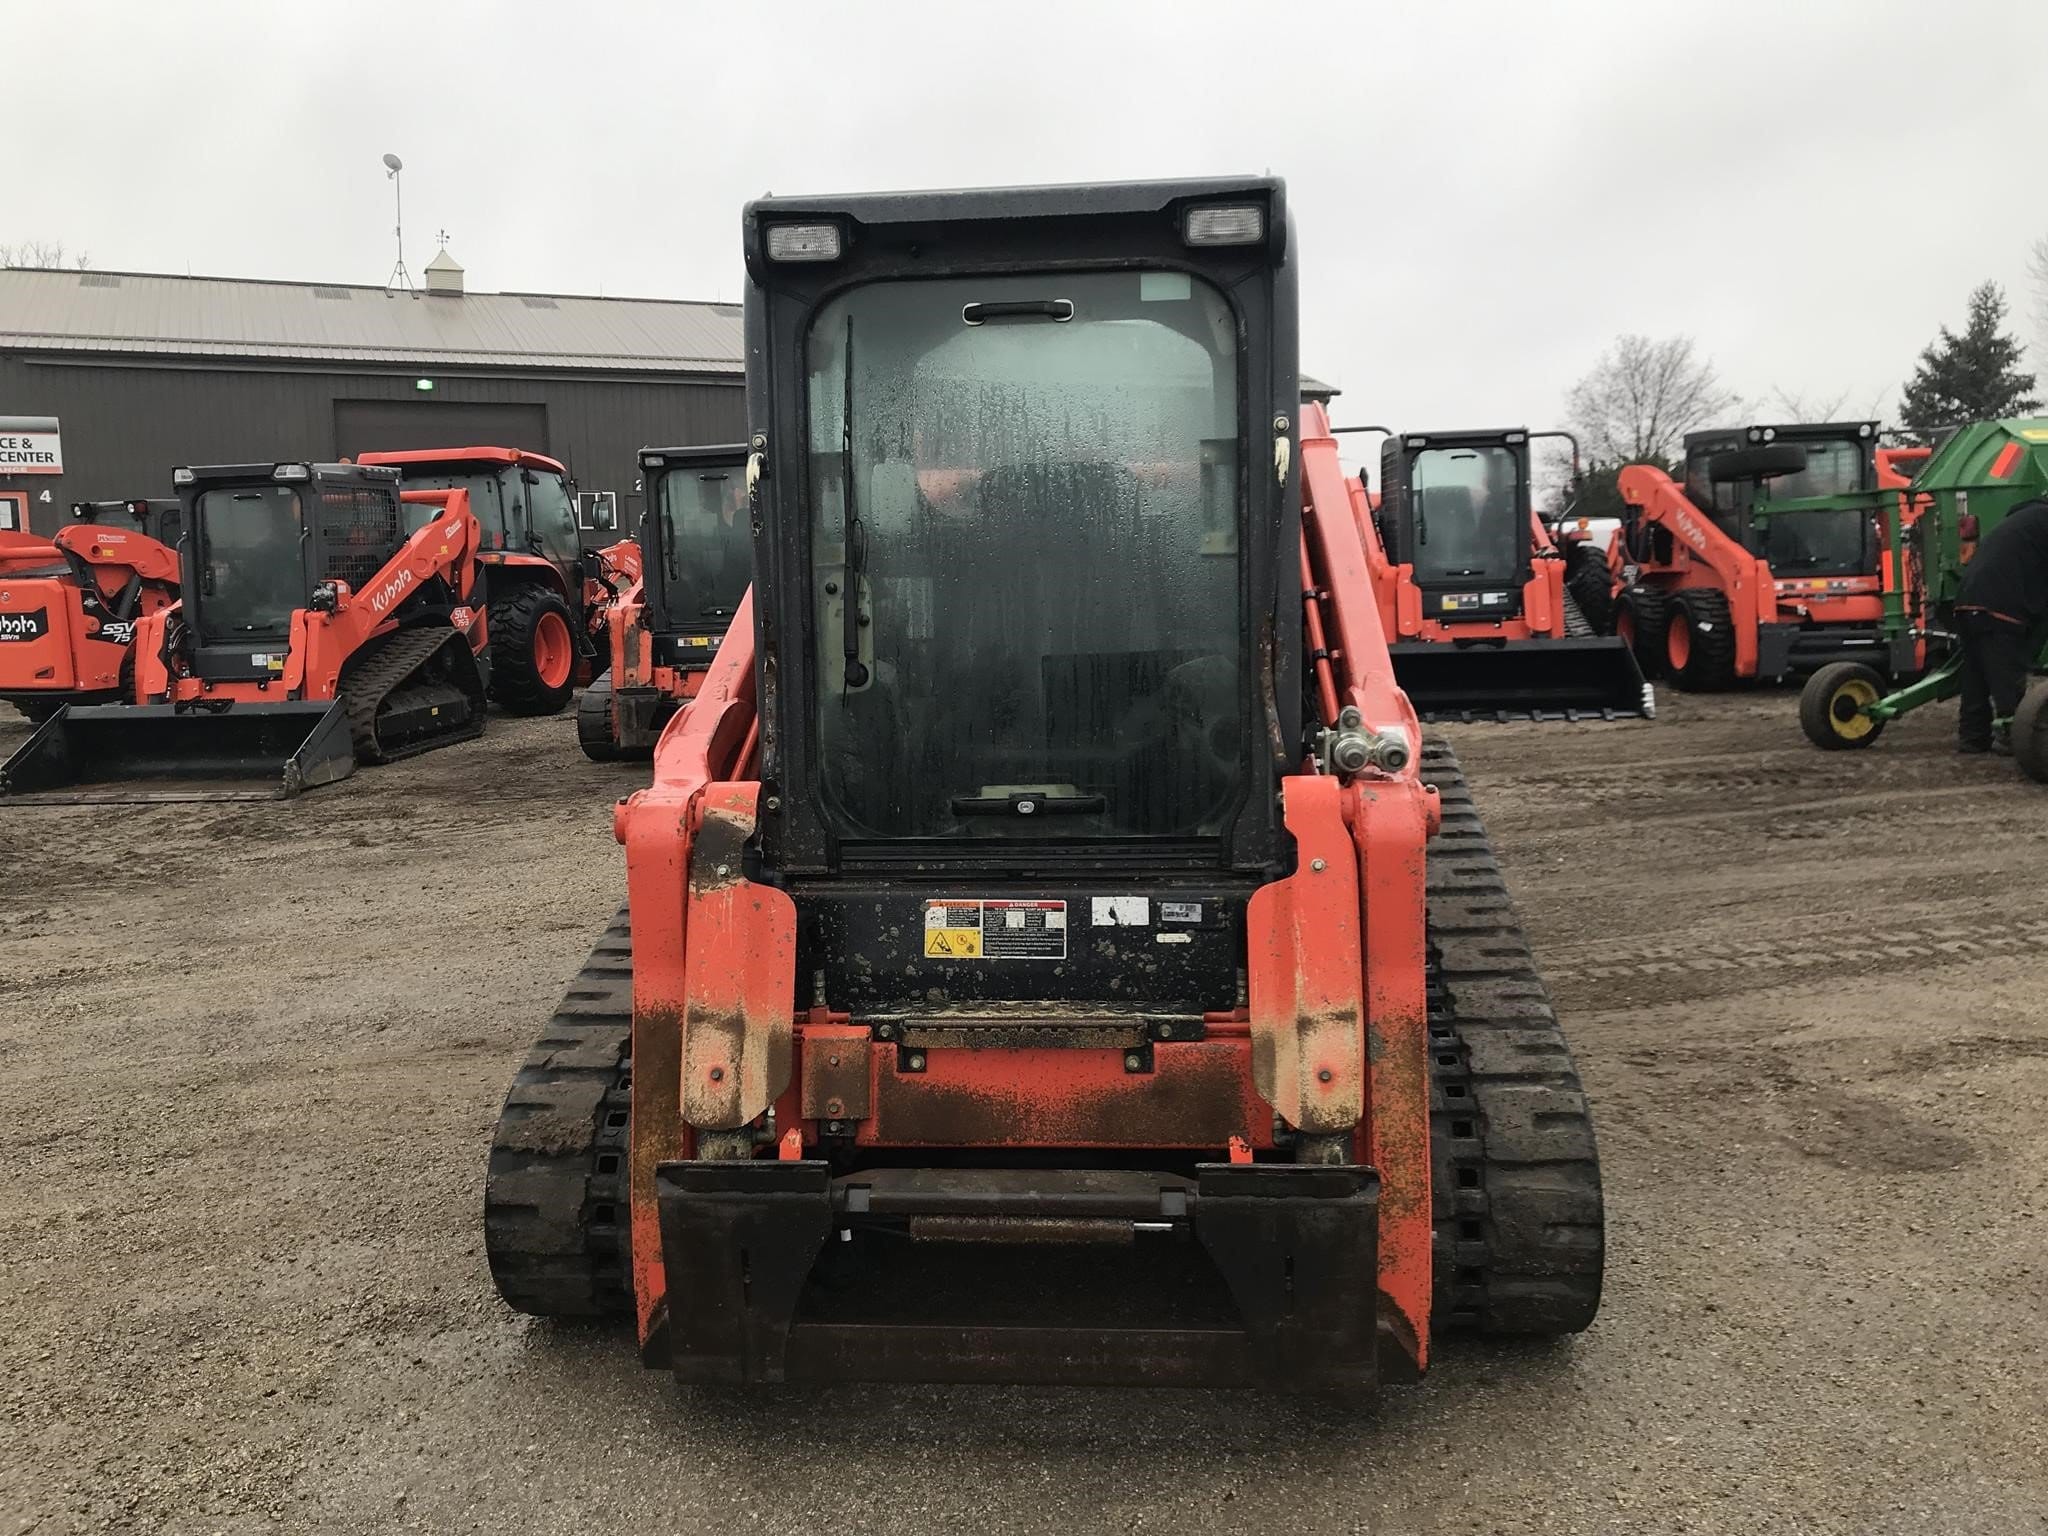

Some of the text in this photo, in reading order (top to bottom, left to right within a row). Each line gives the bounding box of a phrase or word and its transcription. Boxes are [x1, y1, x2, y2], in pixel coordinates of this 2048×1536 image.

[22, 438, 32, 449] &
[0, 452, 54, 463] CENTER
[40, 490, 52, 503] 4
[372, 569, 412, 611] Kubota
[0, 615, 37, 633] bota
[102, 623, 136, 635] SSV
[113, 633, 131, 643] 75
